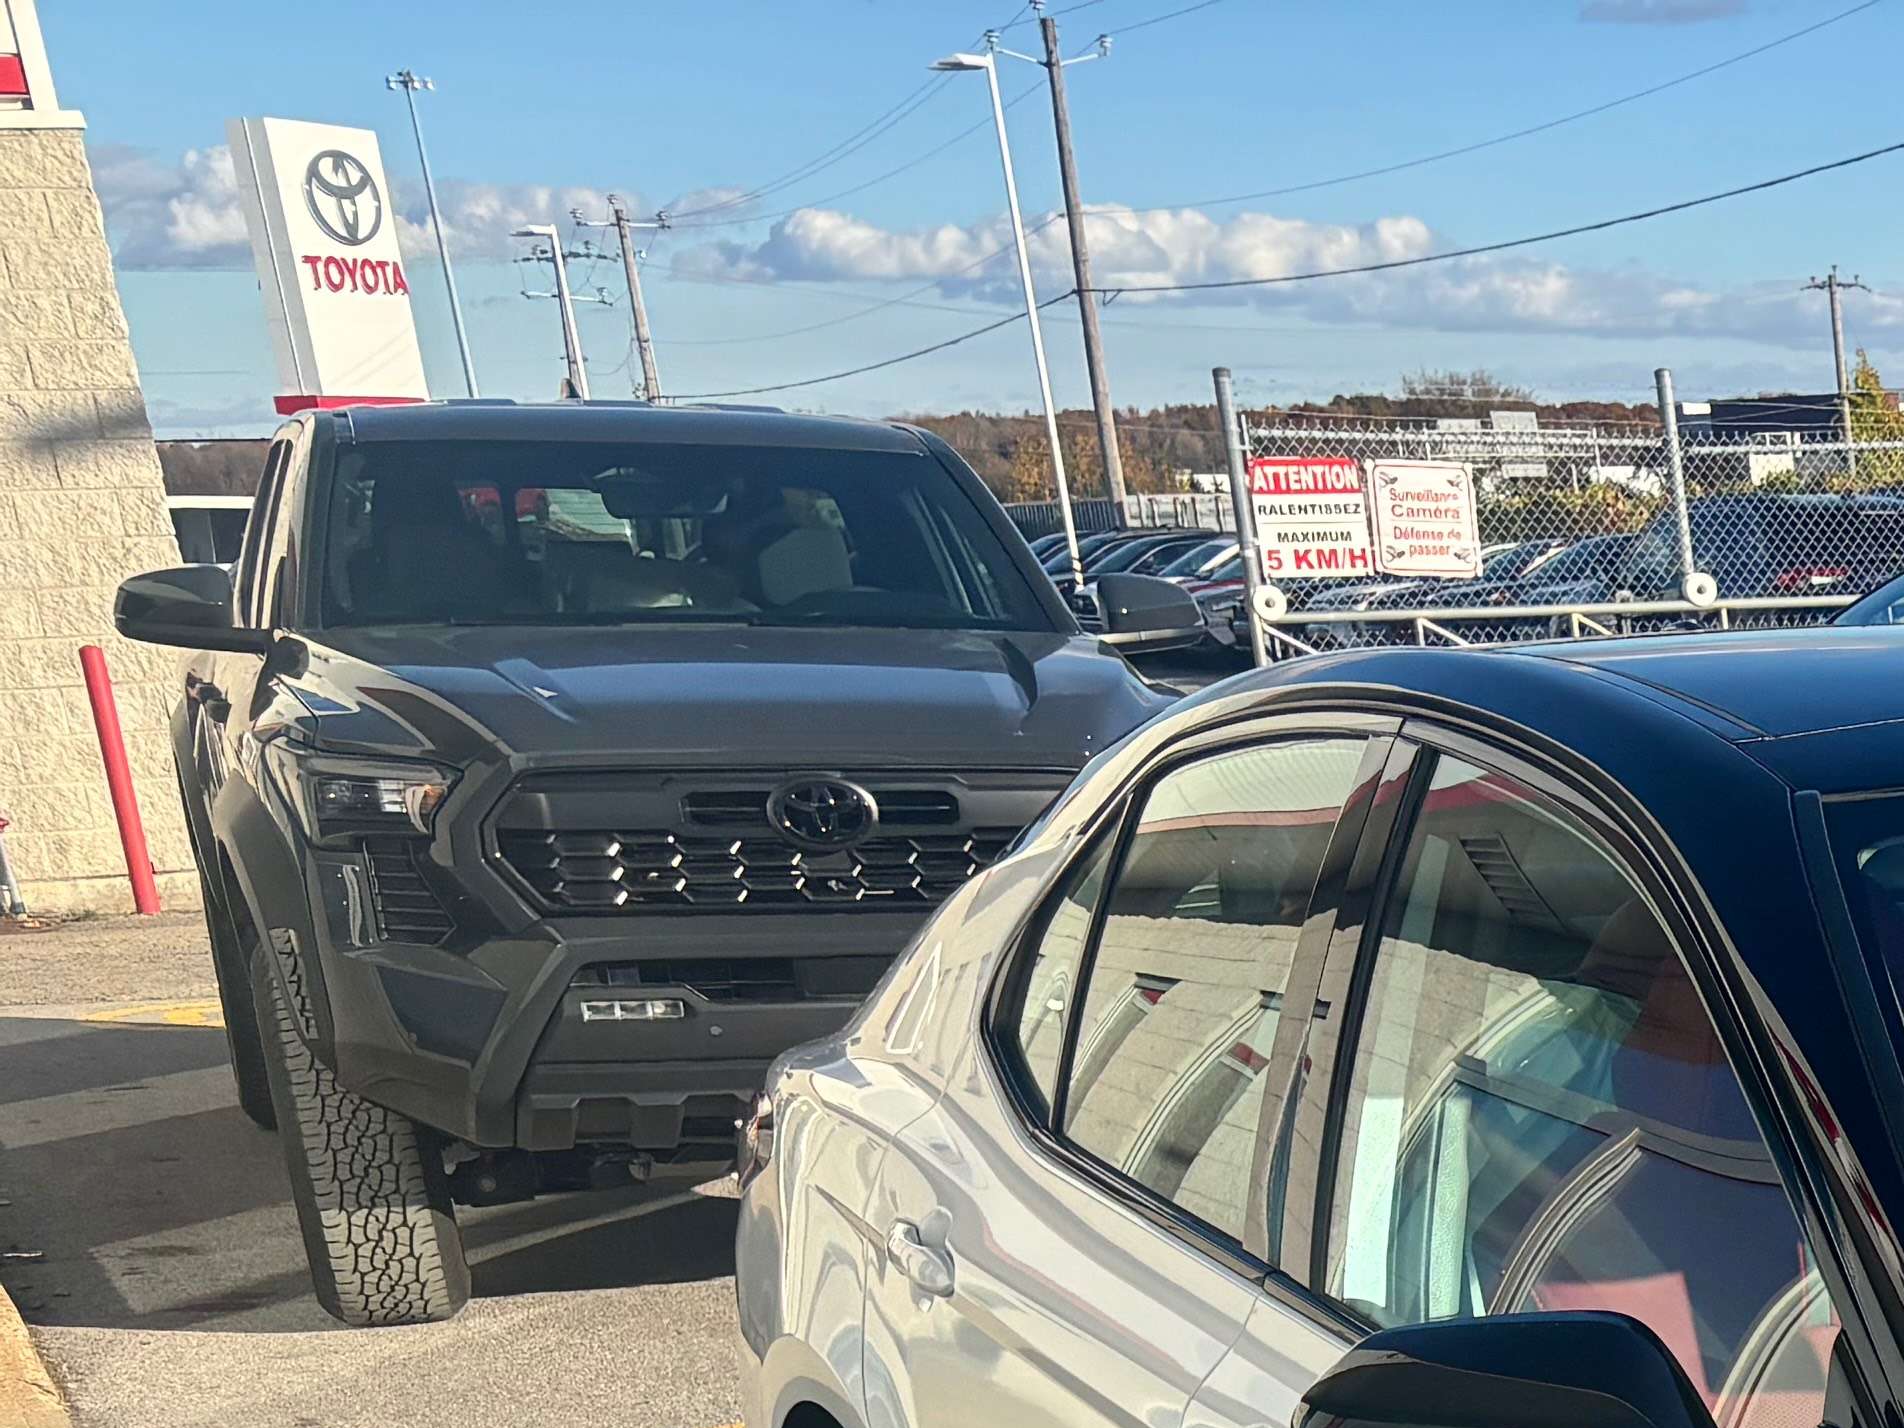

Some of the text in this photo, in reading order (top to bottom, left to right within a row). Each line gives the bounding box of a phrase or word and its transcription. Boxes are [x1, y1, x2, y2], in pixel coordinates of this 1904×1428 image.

[301, 255, 410, 295] TOYOTA
[1253, 465, 1360, 491] ATTENTION
[1389, 487, 1459, 502] Surveillance
[1258, 503, 1361, 516] RALENTISSEZ
[1391, 503, 1460, 519] Caméra
[1277, 530, 1352, 543] MAXIMUM
[1393, 525, 1462, 541] Défense de
[1267, 547, 1368, 570] 5 KM/H
[1409, 544, 1450, 557] passer
